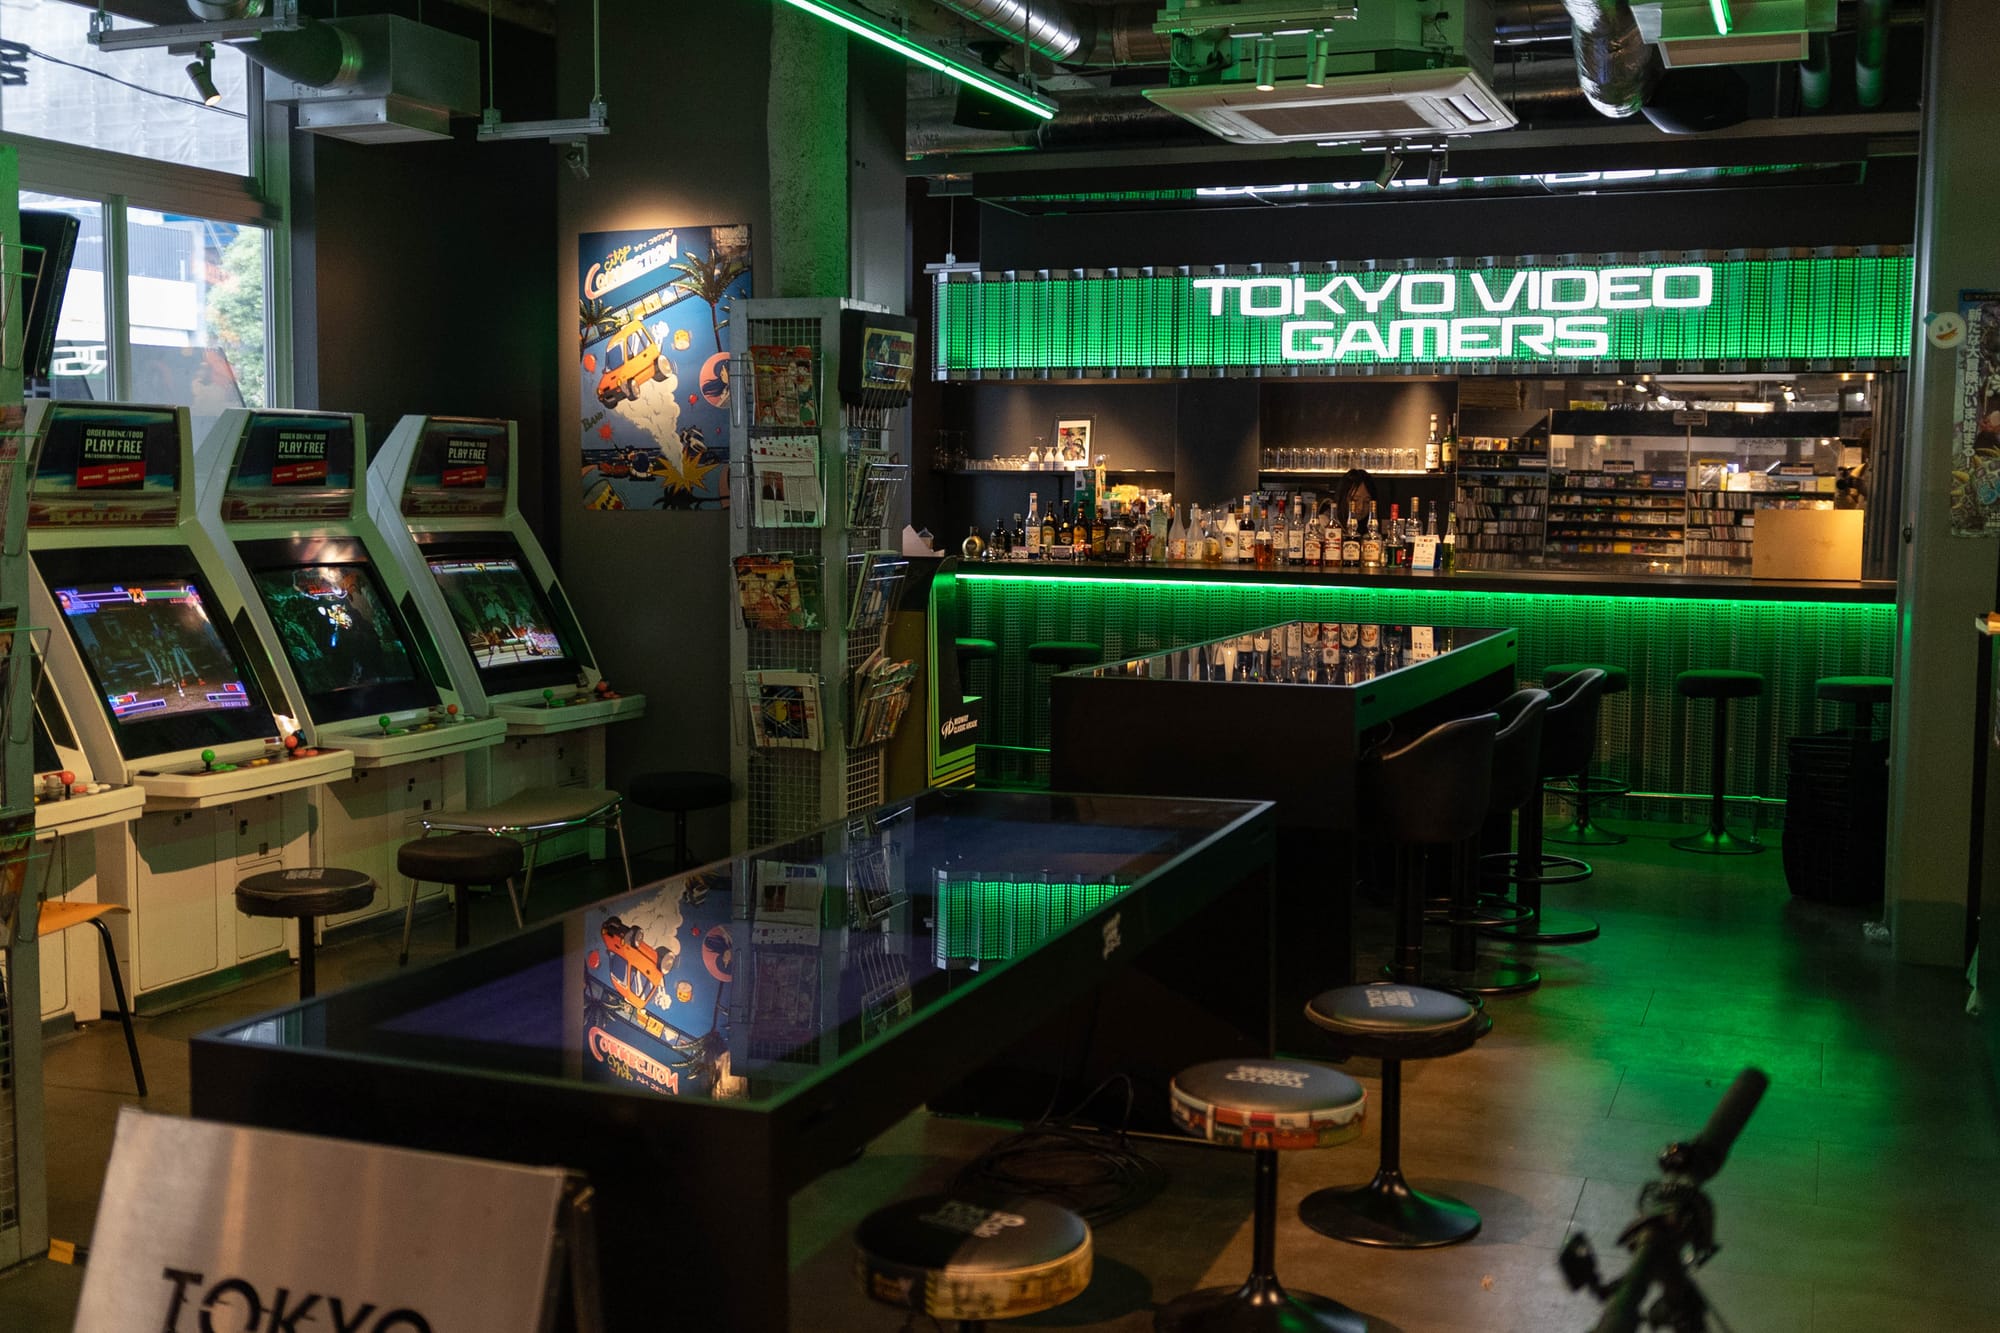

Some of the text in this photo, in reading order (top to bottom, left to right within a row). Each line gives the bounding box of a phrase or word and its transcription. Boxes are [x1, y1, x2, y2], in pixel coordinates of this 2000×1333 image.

[1193, 267, 1713, 316] TOKYO VIDEO
[1281, 316, 1609, 360] GAMERS
[85, 438, 143, 454] PLAY FREE
[278, 440, 326, 454] PLAY FREE
[448, 447, 487, 460] PLAY FREE
